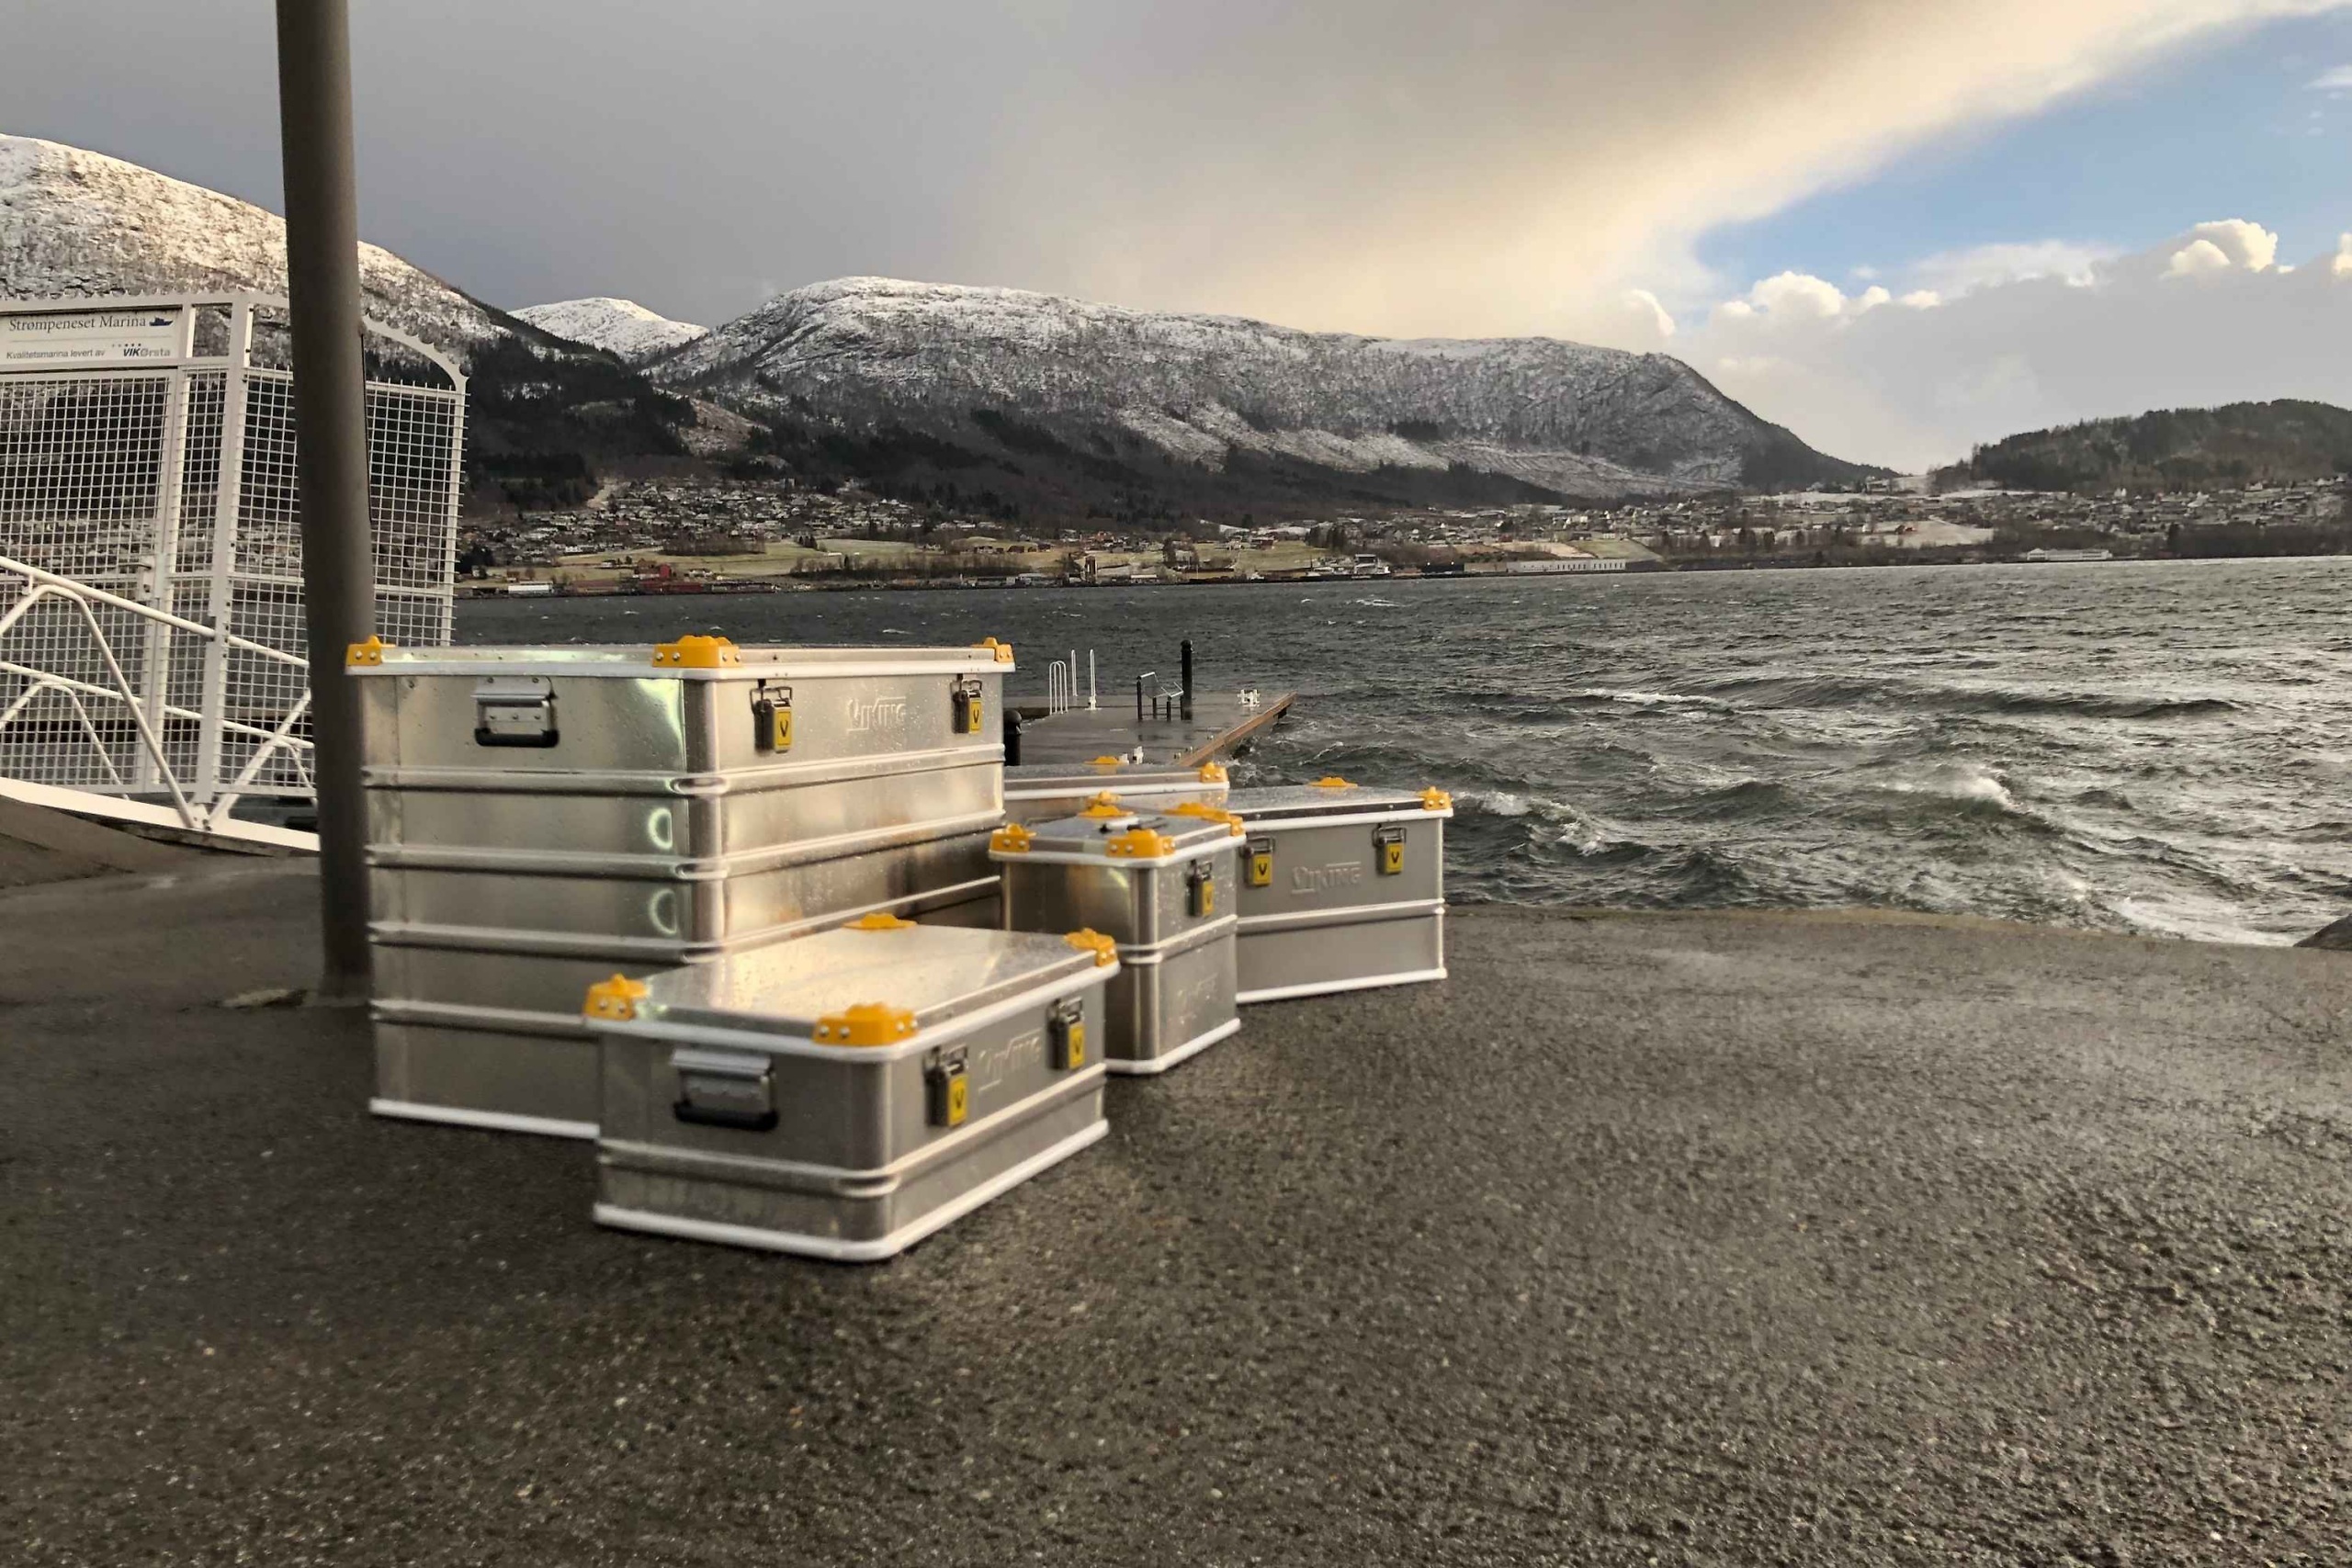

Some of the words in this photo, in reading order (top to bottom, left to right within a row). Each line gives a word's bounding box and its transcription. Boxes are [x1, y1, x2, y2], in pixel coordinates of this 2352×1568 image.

[9, 317, 96, 333] Strømpeneset
[99, 315, 146, 329] Marina
[6, 349, 69, 360] Kvalitetsmarina
[70, 349, 93, 358] levert
[973, 709, 980, 724] V
[779, 720, 789, 738] V
[1391, 852, 1400, 864] V
[1258, 863, 1268, 876] V
